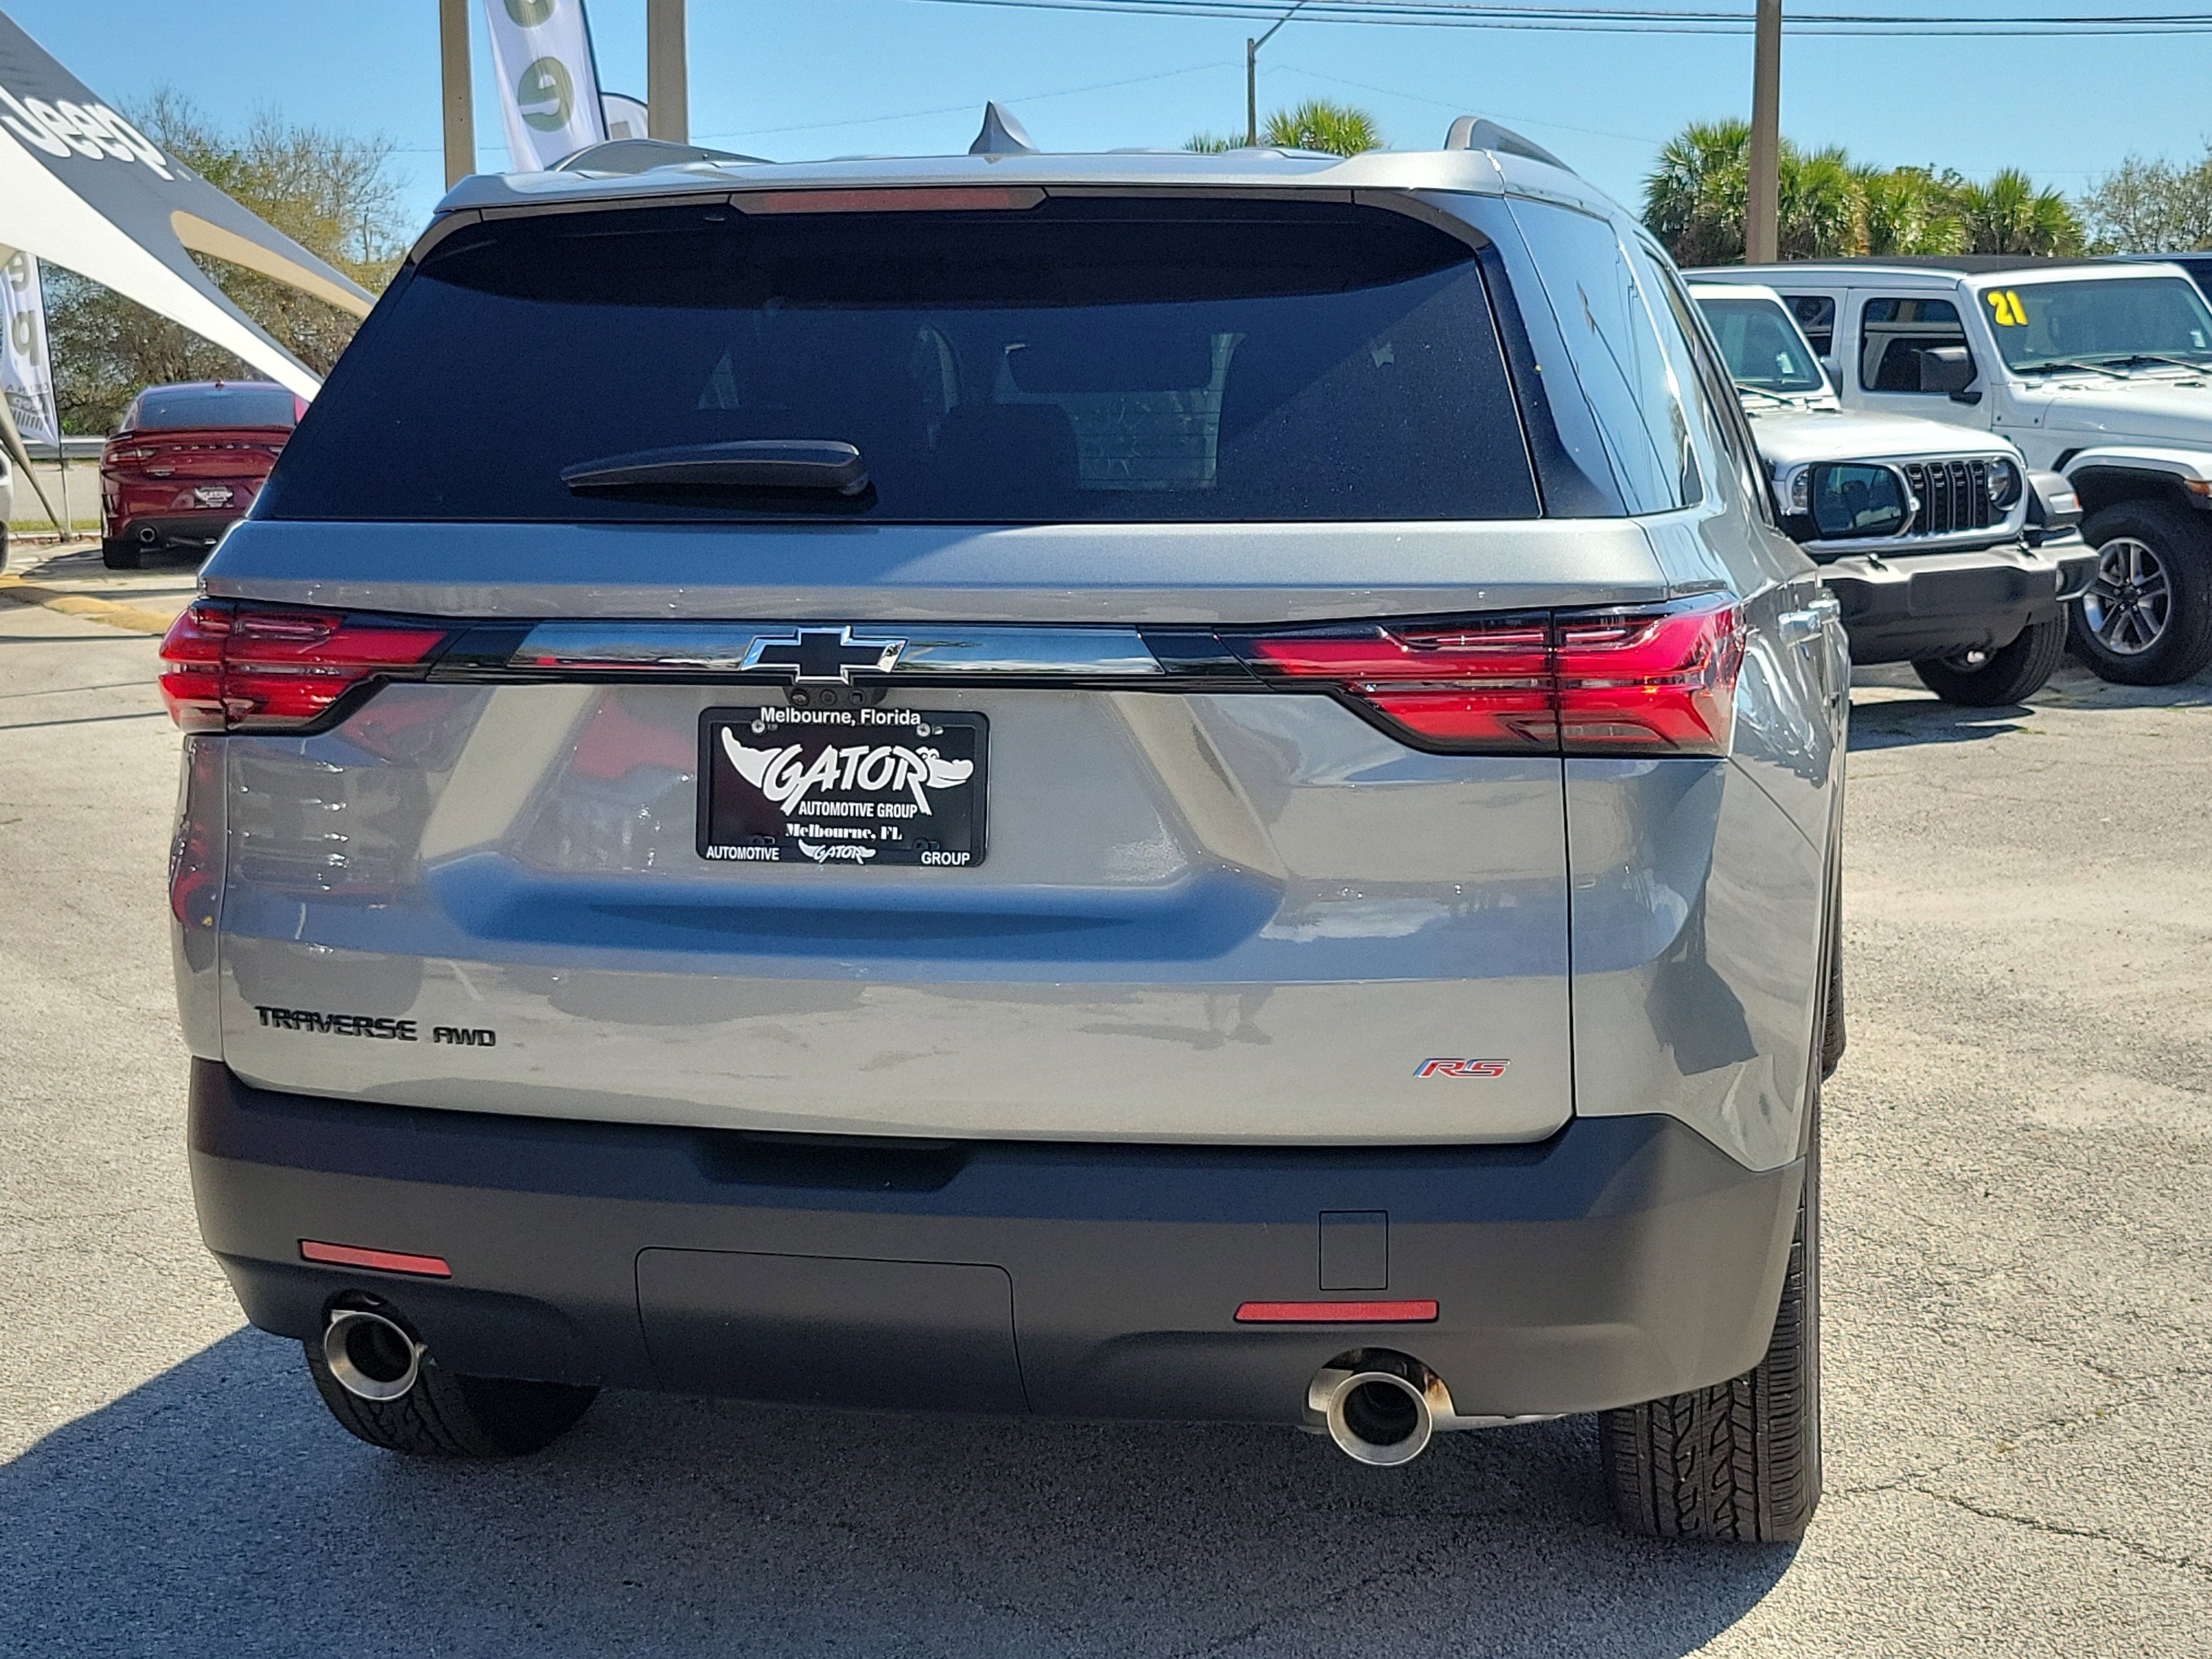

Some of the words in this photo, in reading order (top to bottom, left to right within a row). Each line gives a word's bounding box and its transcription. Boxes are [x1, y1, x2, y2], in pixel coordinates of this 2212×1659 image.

[0, 86, 175, 181] Jeep
[1987, 291, 2029, 326] 21
[761, 708, 855, 726] Melbourne,
[861, 709, 921, 725] Florida
[763, 744, 932, 816] GATOR
[799, 802, 874, 817] AUTOMOTIVE
[877, 804, 918, 818] GROUP
[786, 823, 876, 840] Melbourne,
[881, 825, 902, 840] FL
[707, 845, 780, 860] AUTOMOTIVE
[812, 843, 865, 864] GATOR
[921, 851, 970, 866] GROUP
[255, 1006, 418, 1041] TRAVERSE
[433, 1026, 496, 1047] AWD
[1413, 1058, 1510, 1078] RS
